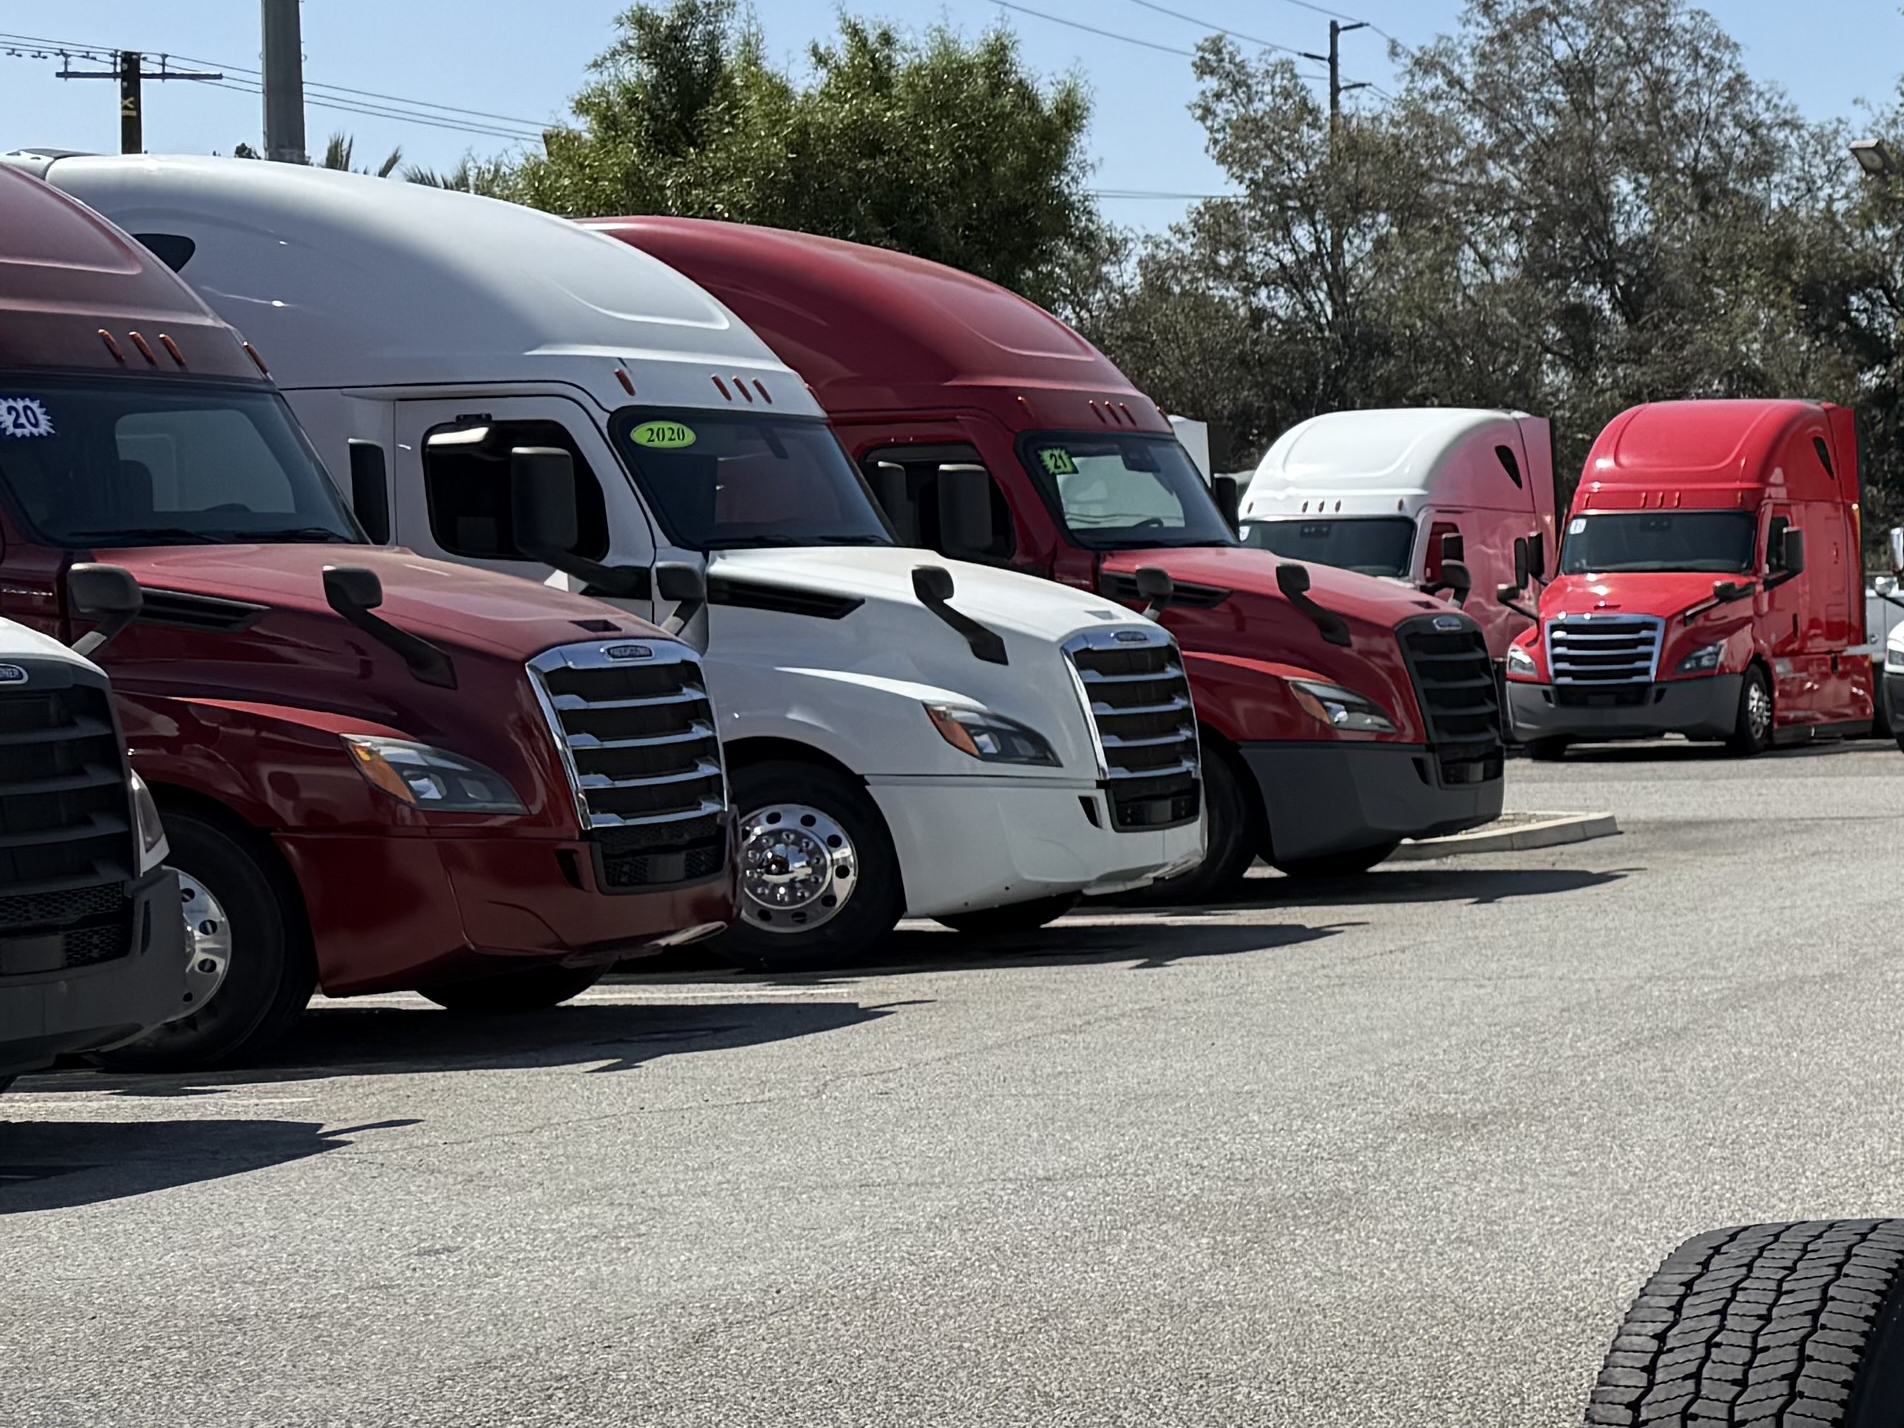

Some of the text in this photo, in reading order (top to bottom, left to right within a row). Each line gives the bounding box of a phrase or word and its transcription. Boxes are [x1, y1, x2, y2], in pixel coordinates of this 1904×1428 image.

[6, 404, 40, 429] 20
[646, 426, 686, 443] 2020
[1049, 453, 1067, 469] 21
